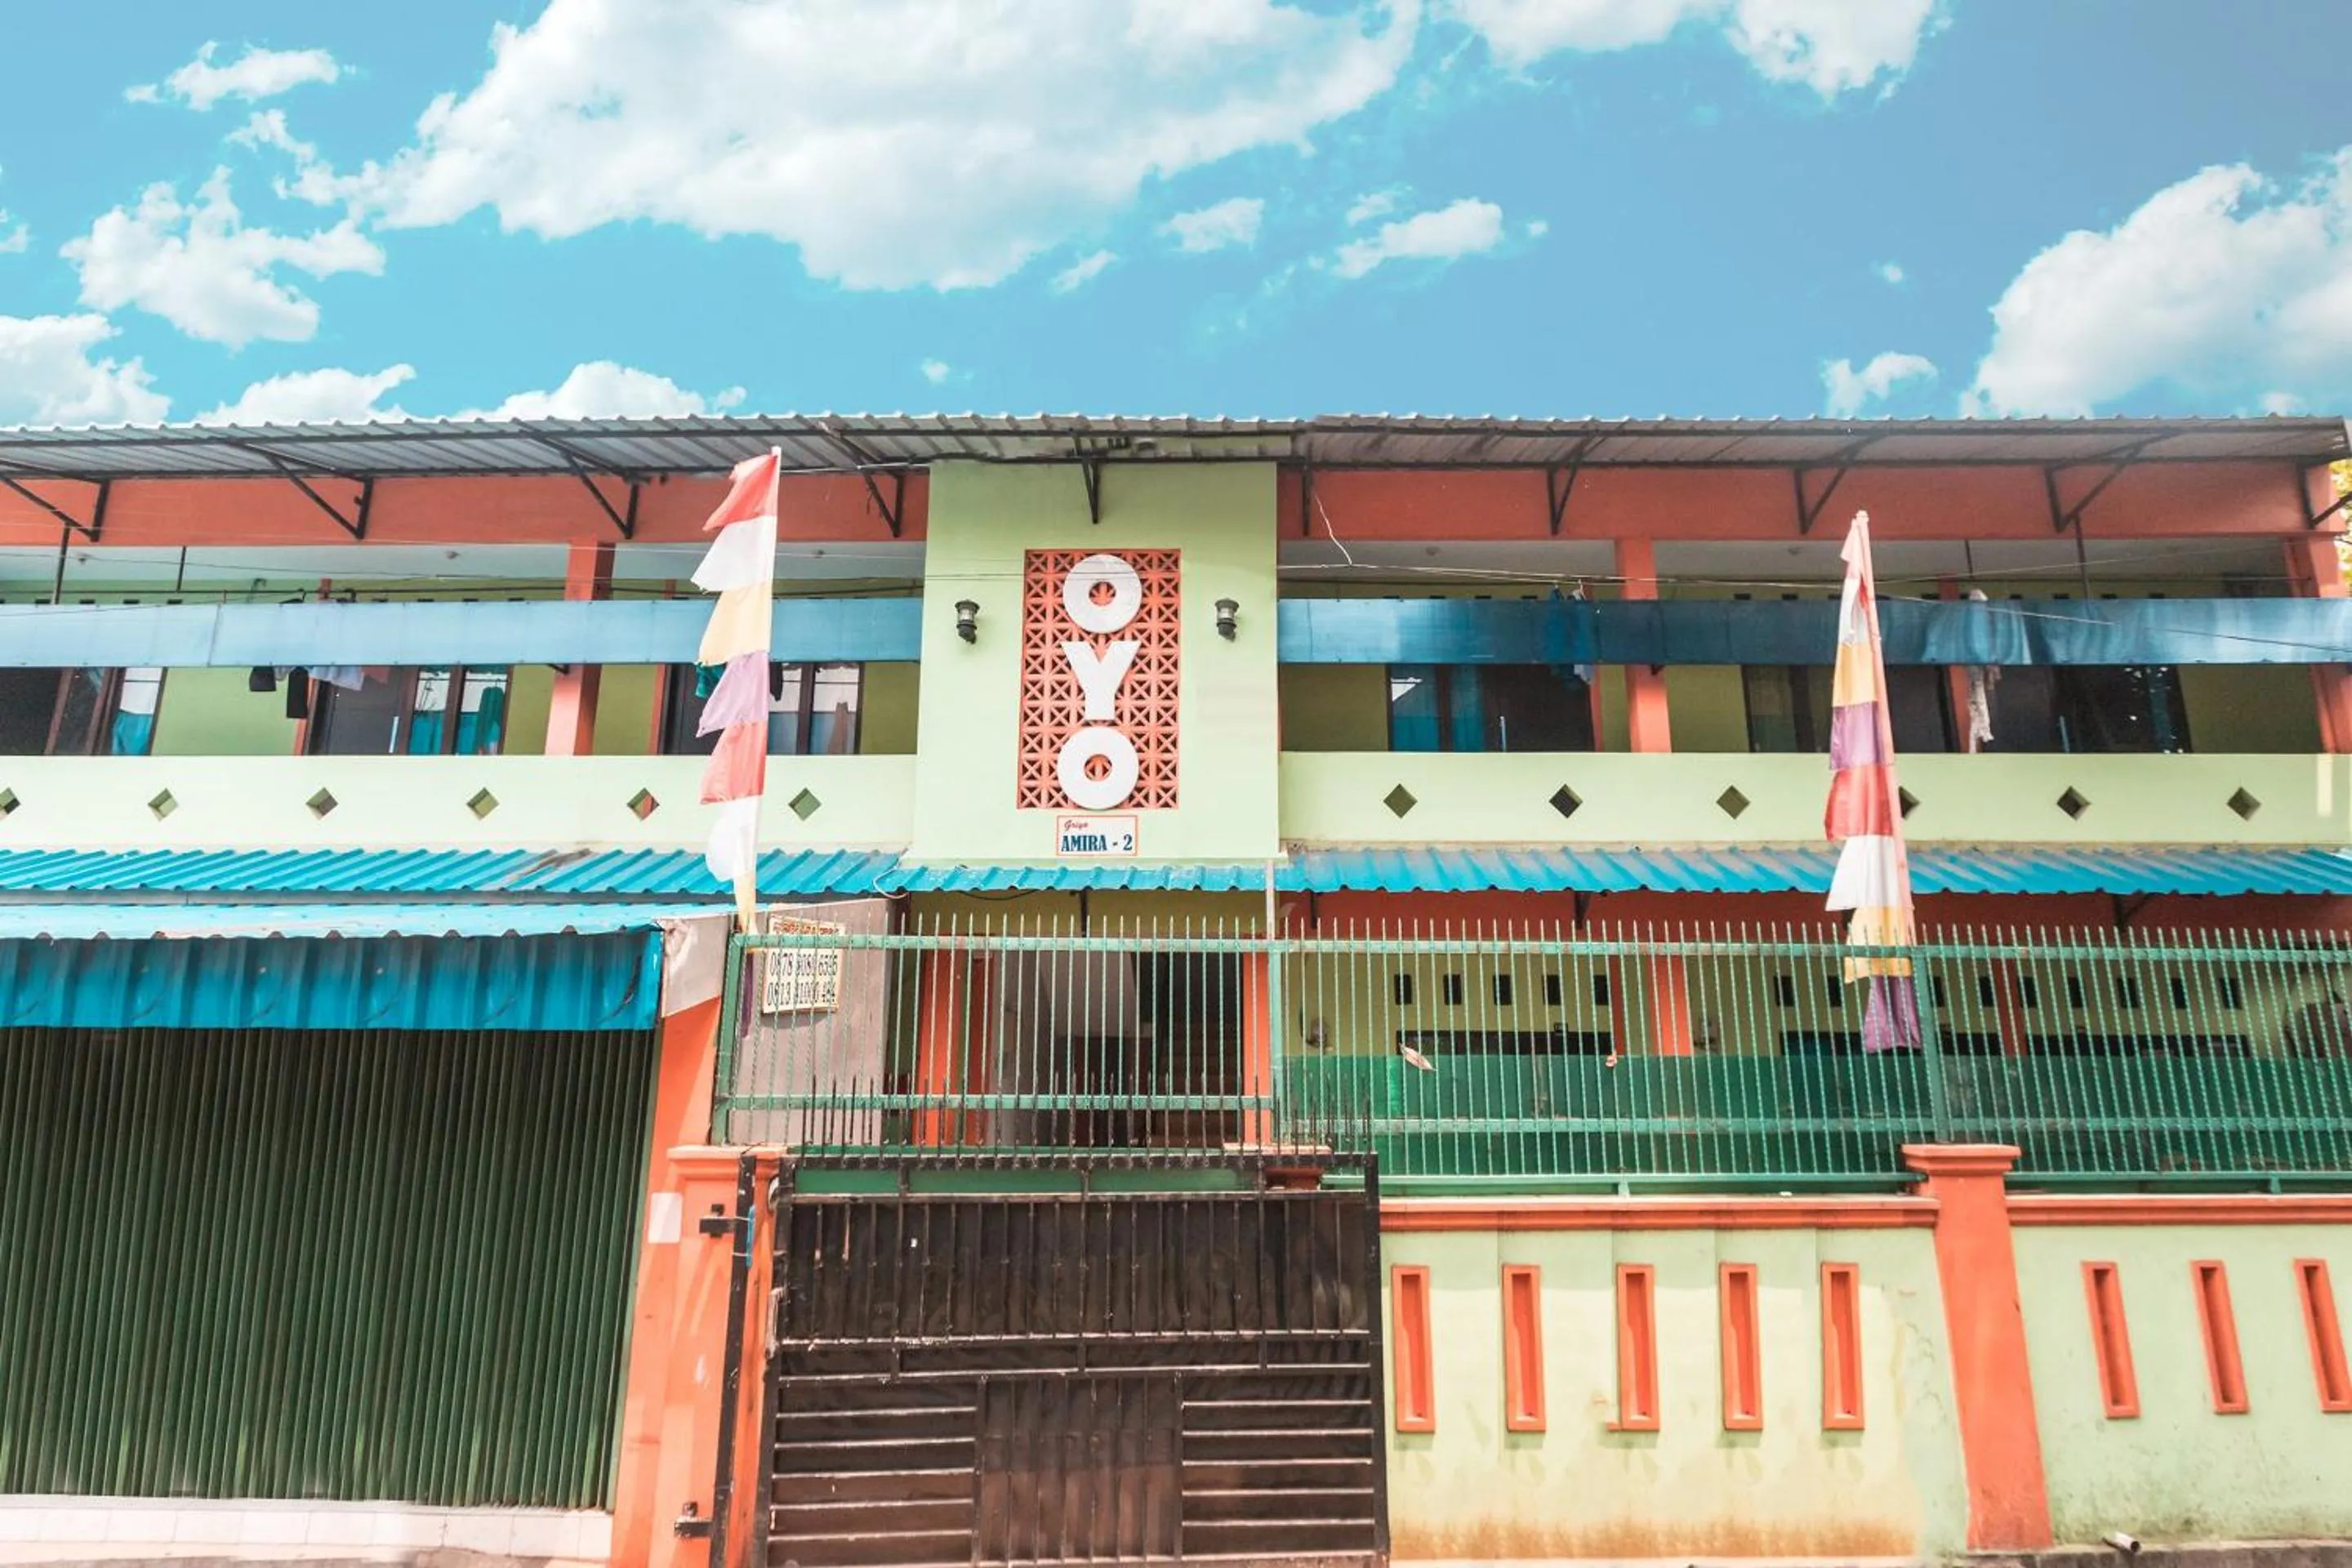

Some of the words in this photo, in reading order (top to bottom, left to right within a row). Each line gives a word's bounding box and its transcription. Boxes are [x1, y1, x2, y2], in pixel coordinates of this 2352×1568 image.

[1057, 554, 1143, 809] OYO
[1064, 820, 1089, 831] Griya
[1062, 835, 1107, 851] AMIRA
[1123, 834, 1133, 850] 2
